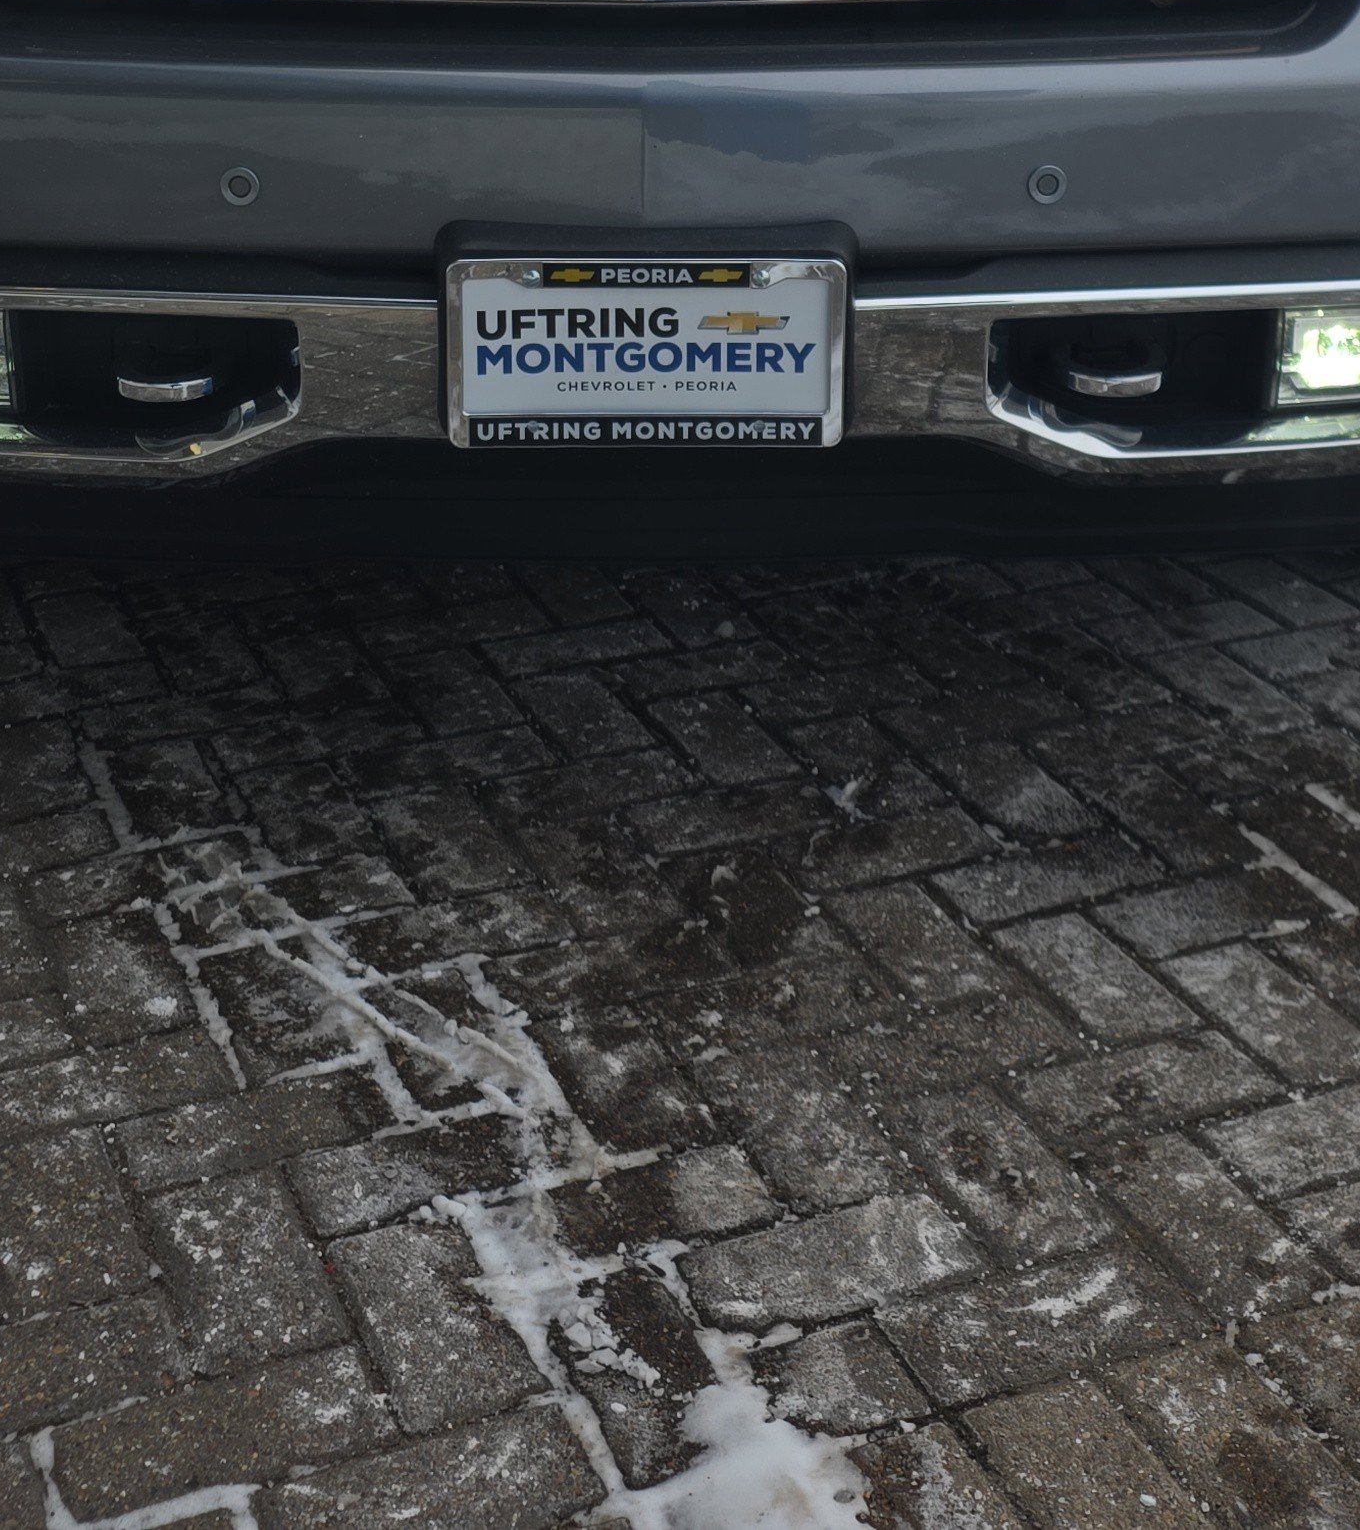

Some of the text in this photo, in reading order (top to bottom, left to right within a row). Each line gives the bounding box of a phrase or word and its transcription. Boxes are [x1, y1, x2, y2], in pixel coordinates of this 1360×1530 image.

[600, 267, 694, 285] PEORIA
[476, 306, 680, 342] UFTRING
[476, 341, 817, 376] MONTGOMERY
[556, 380, 738, 393] CHEVROLET PEORIA
[476, 421, 816, 442] UFTRING MONTGOMERY
